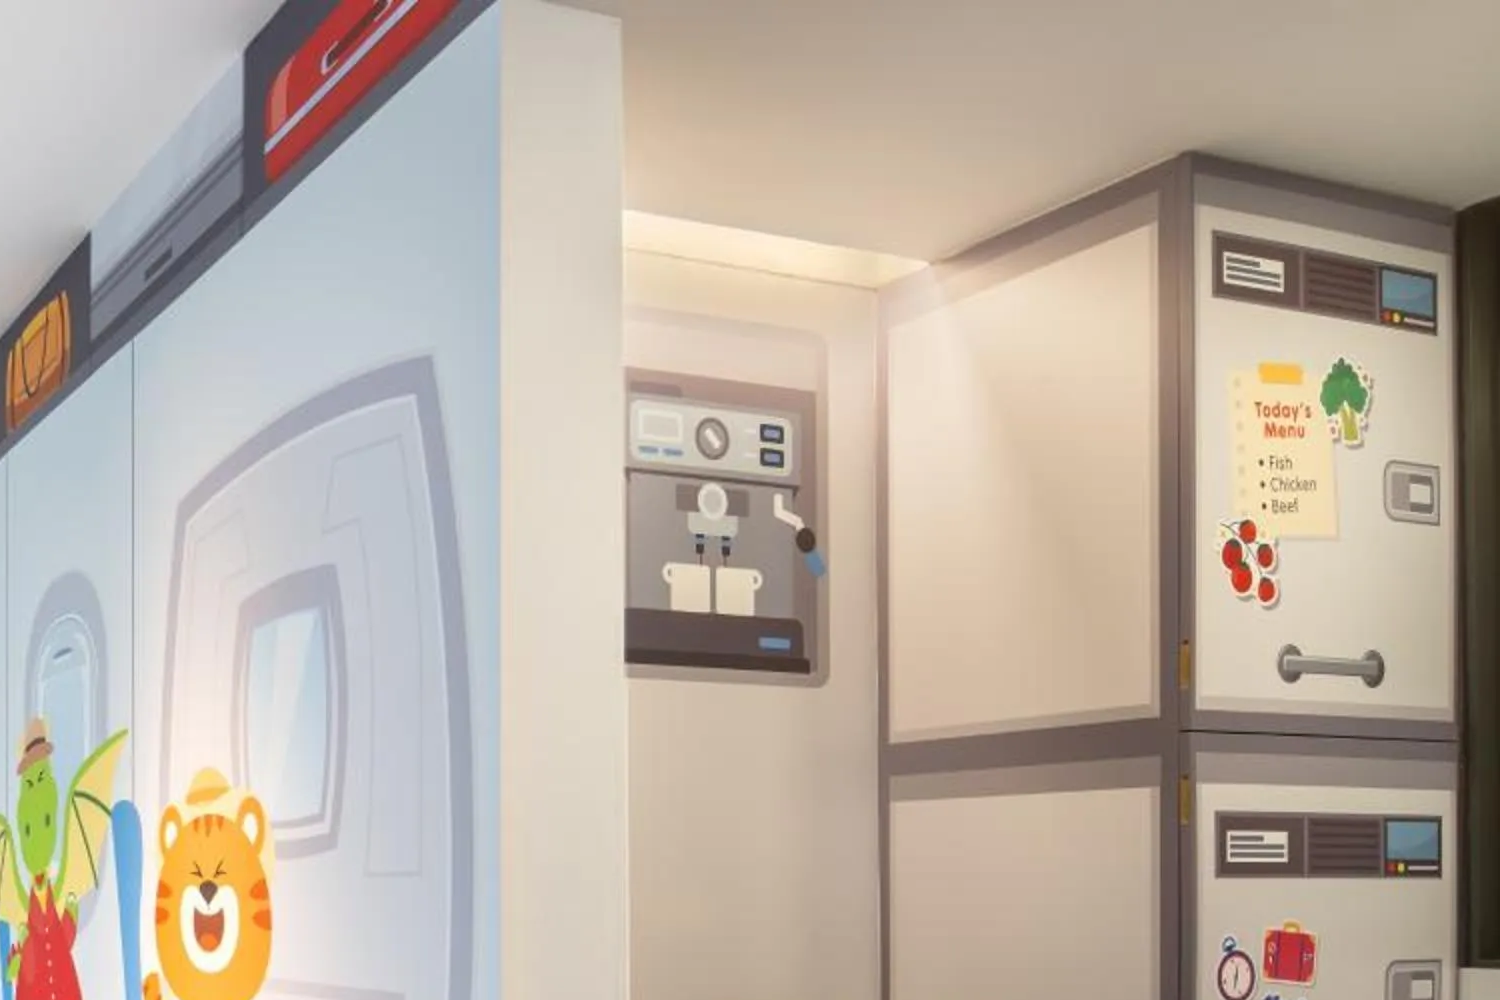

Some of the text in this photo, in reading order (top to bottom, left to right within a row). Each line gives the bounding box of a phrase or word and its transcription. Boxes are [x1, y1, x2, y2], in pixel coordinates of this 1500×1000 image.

[1255, 402, 1312, 421] Today's
[1264, 423, 1305, 438] Menu
[1269, 455, 1293, 470] Fish
[1270, 476, 1317, 492] Chicken
[1271, 498, 1299, 513] Beef
